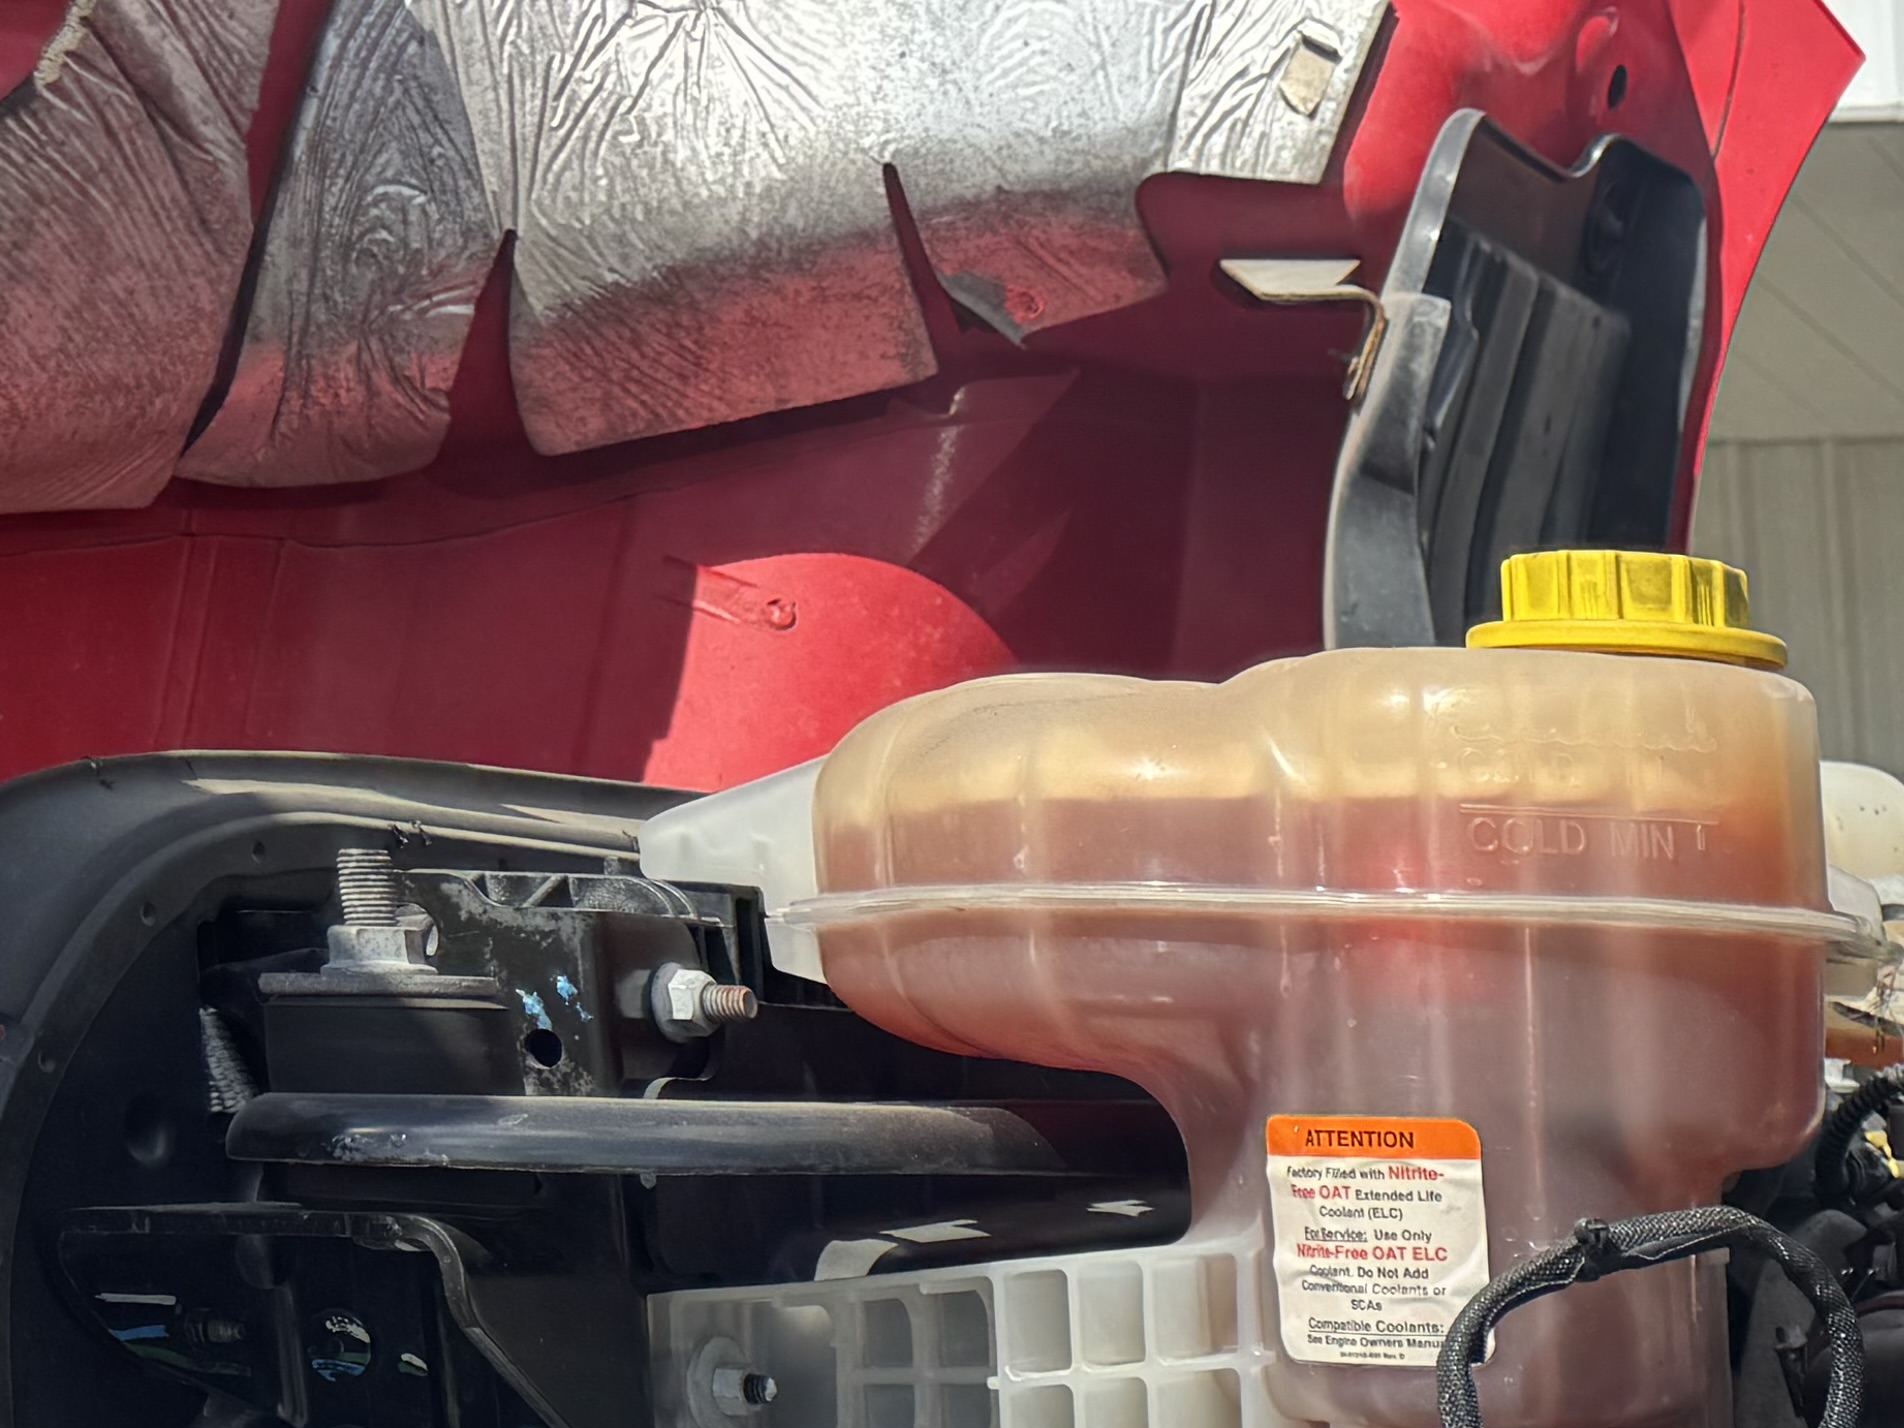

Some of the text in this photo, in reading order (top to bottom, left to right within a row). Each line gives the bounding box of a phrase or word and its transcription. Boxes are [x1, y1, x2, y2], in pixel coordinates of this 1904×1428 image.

[1467, 816, 1674, 859] COLD MIN
[1305, 1129, 1414, 1149] ATTENTION
[1286, 1166, 1322, 1180] Factory
[1326, 1167, 1356, 1179] Filled
[1360, 1169, 1385, 1180] with
[1291, 1184, 1442, 1202] Free OAT Extended Life
[1319, 1206, 1403, 1221] Coolant (ELC)
[1374, 1229, 1397, 1240] Use
[1402, 1230, 1432, 1243] Only
[1296, 1243, 1448, 1261] Nitrite-Free OAT ELC
[1357, 1267, 1373, 1278] Do
[1377, 1267, 1399, 1279] Not
[1403, 1268, 1429, 1279] Add
[1302, 1280, 1446, 1296] Conventional Coolants or
[1351, 1300, 1382, 1311] SCAs
[1308, 1317, 1444, 1334] Compatible Coolants:
[1307, 1335, 1323, 1345] See
[1325, 1335, 1357, 1347] Engine
[1361, 1337, 1403, 1348] Owners
